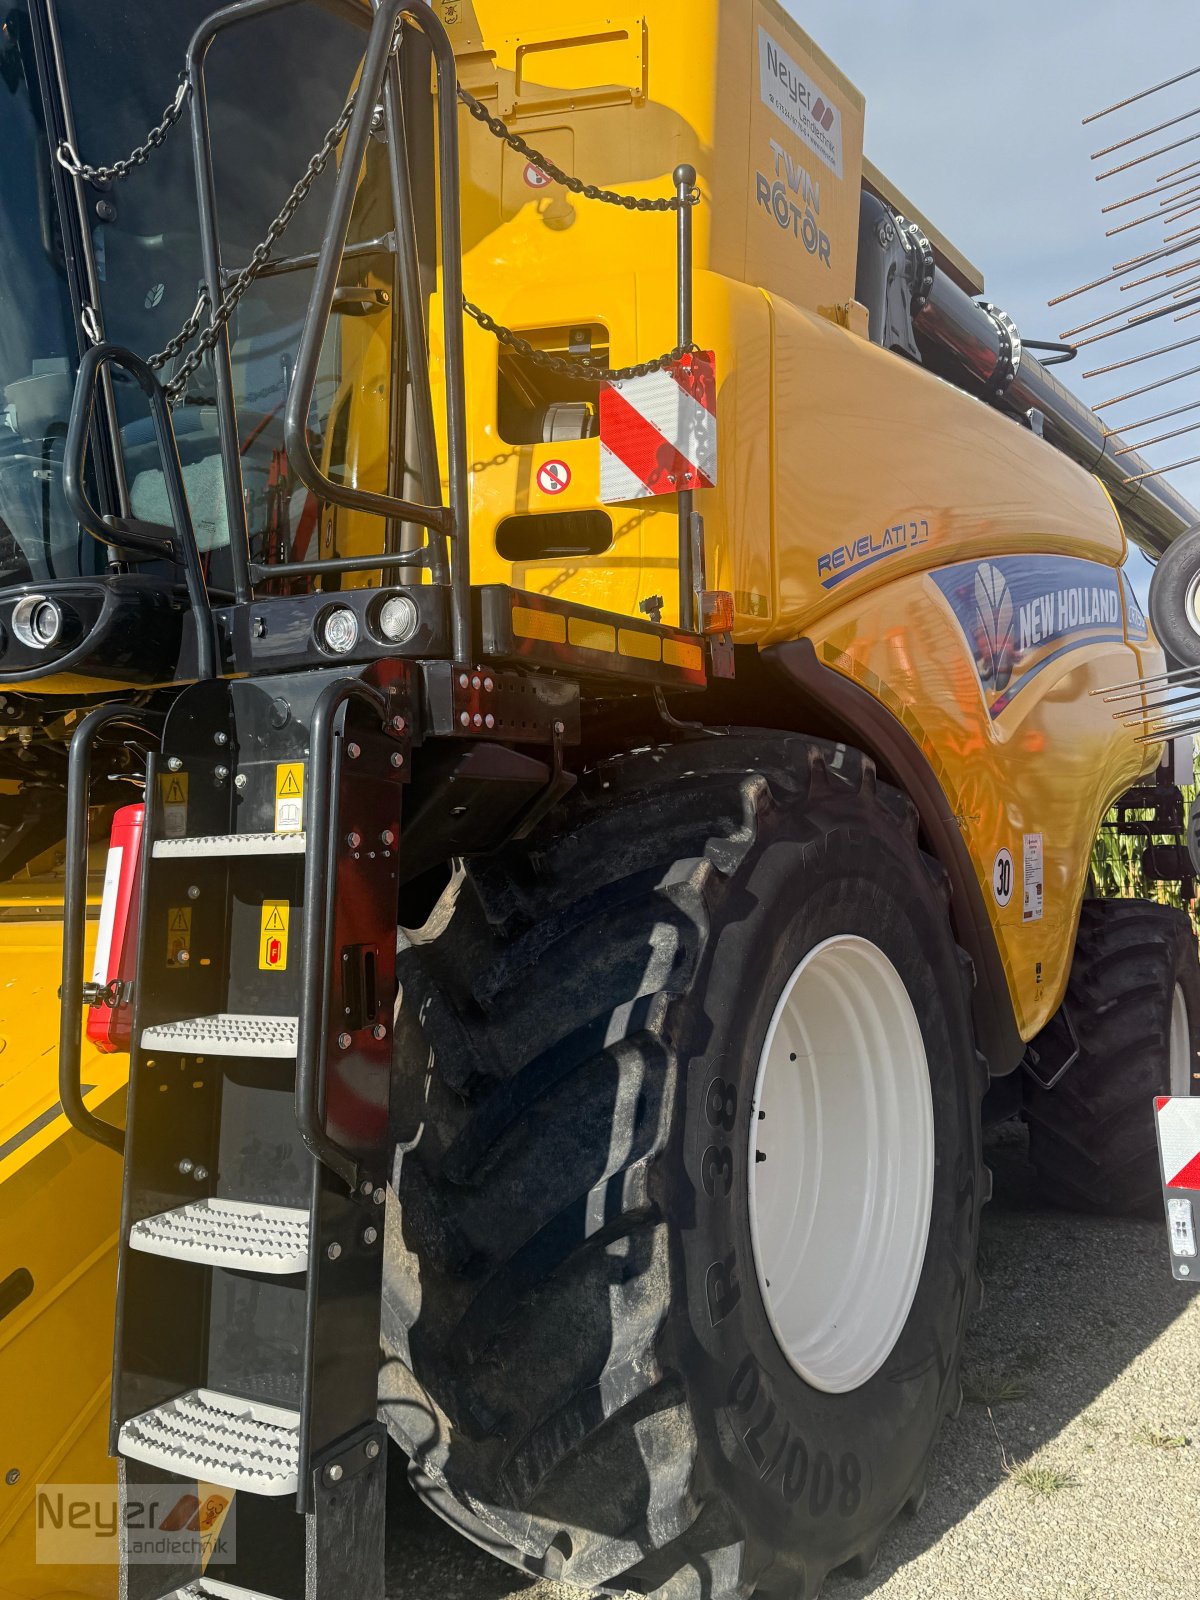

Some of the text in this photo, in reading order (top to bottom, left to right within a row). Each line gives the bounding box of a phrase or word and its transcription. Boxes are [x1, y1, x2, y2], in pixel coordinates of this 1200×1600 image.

[767, 41, 811, 111] Neyer
[798, 108, 835, 153] Landtechnik
[768, 137, 819, 216] TWIN
[756, 170, 832, 270] ROTOR
[1019, 591, 1055, 653] NEW
[1057, 587, 1119, 632] HOLLAND
[996, 858, 1011, 897] 30
